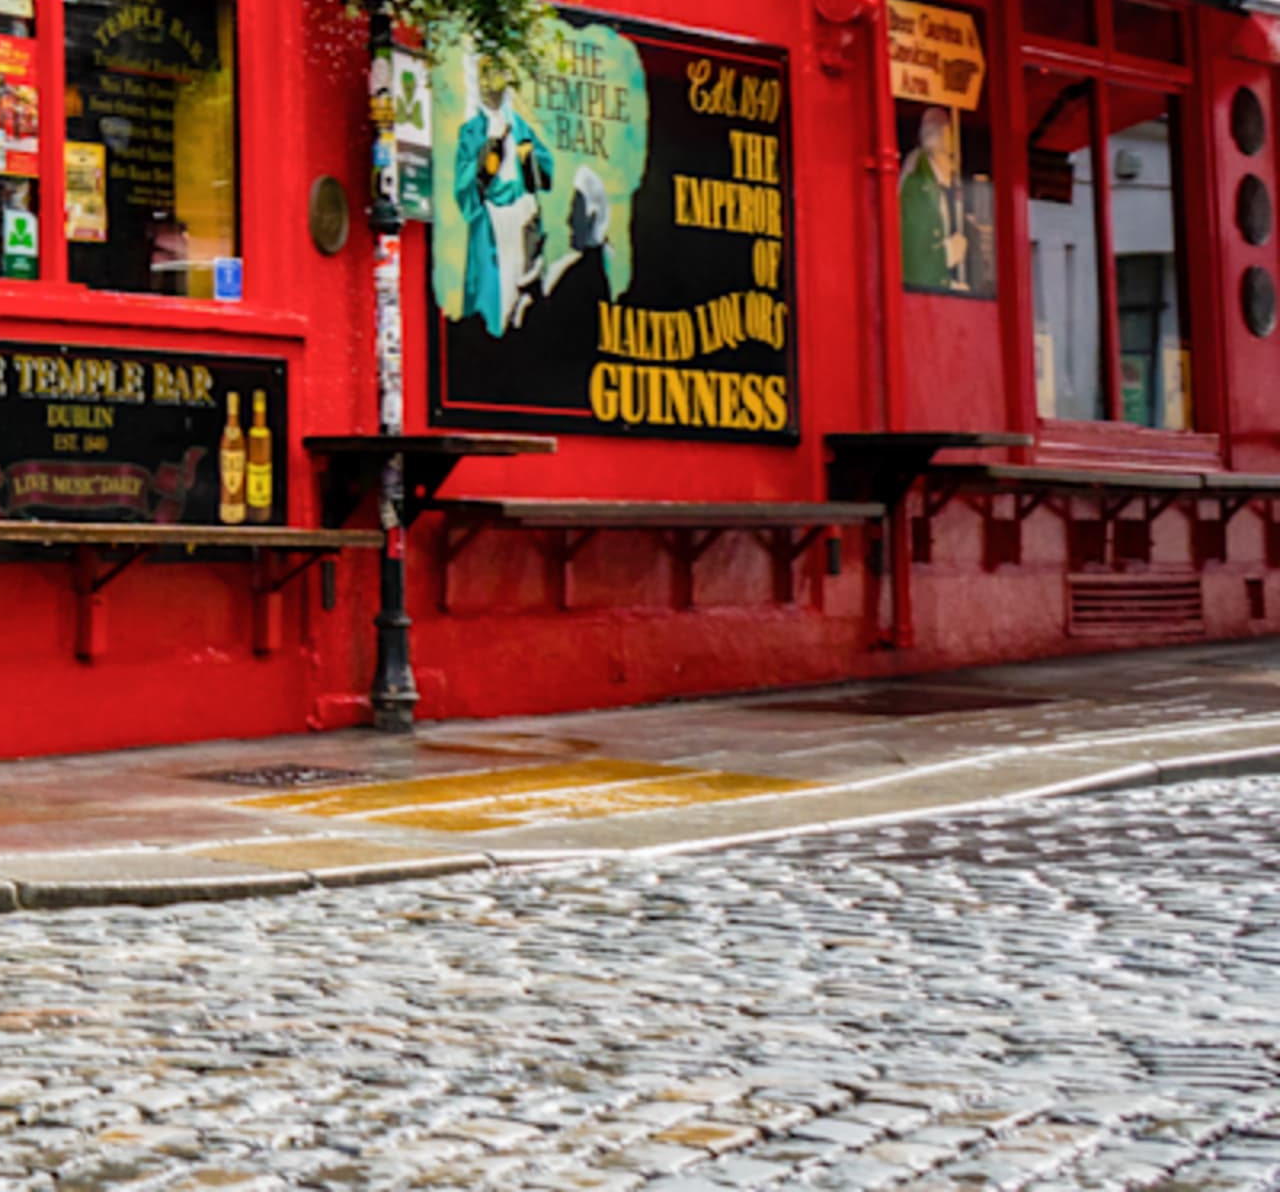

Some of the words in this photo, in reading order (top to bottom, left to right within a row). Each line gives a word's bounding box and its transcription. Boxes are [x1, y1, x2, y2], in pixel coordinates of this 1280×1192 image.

[919, 11, 964, 47] Garden
[528, 69, 631, 124] TEMPLE
[556, 114, 609, 160] BAR
[729, 128, 779, 185] THE
[673, 173, 783, 238] EMPEROR
[753, 238, 782, 290] OF
[596, 299, 695, 362] MALTED
[695, 290, 788, 356] LIQUORS
[14, 353, 146, 403] TEMPLE
[152, 361, 217, 407] BAR
[589, 361, 787, 432] GUINNESS
[47, 404, 115, 429] DUBLIN
[13, 471, 49, 496] LIVE
[52, 472, 96, 497] MUSIC
